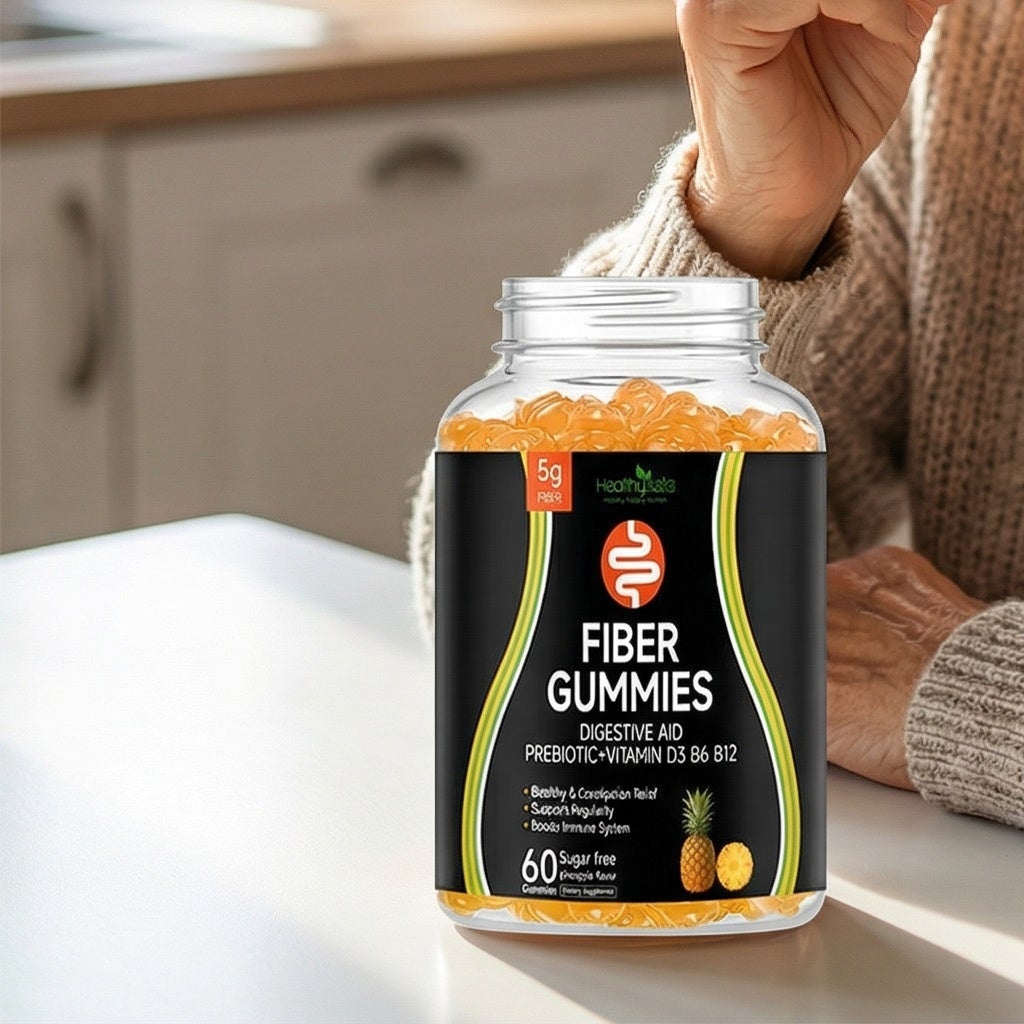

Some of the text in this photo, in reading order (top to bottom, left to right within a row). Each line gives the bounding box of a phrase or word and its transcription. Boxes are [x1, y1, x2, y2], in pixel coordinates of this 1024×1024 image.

[538, 458, 562, 489] 5g
[582, 622, 680, 663] FIBER
[547, 670, 713, 712] GUMMIES
[580, 723, 683, 741] DIGESTIVE AID
[525, 744, 738, 764] PREBIOTIC+VITAMIN D3 B6 B12
[522, 848, 557, 884] 60
[560, 850, 591, 869] Sugar
[594, 851, 616, 866] free
